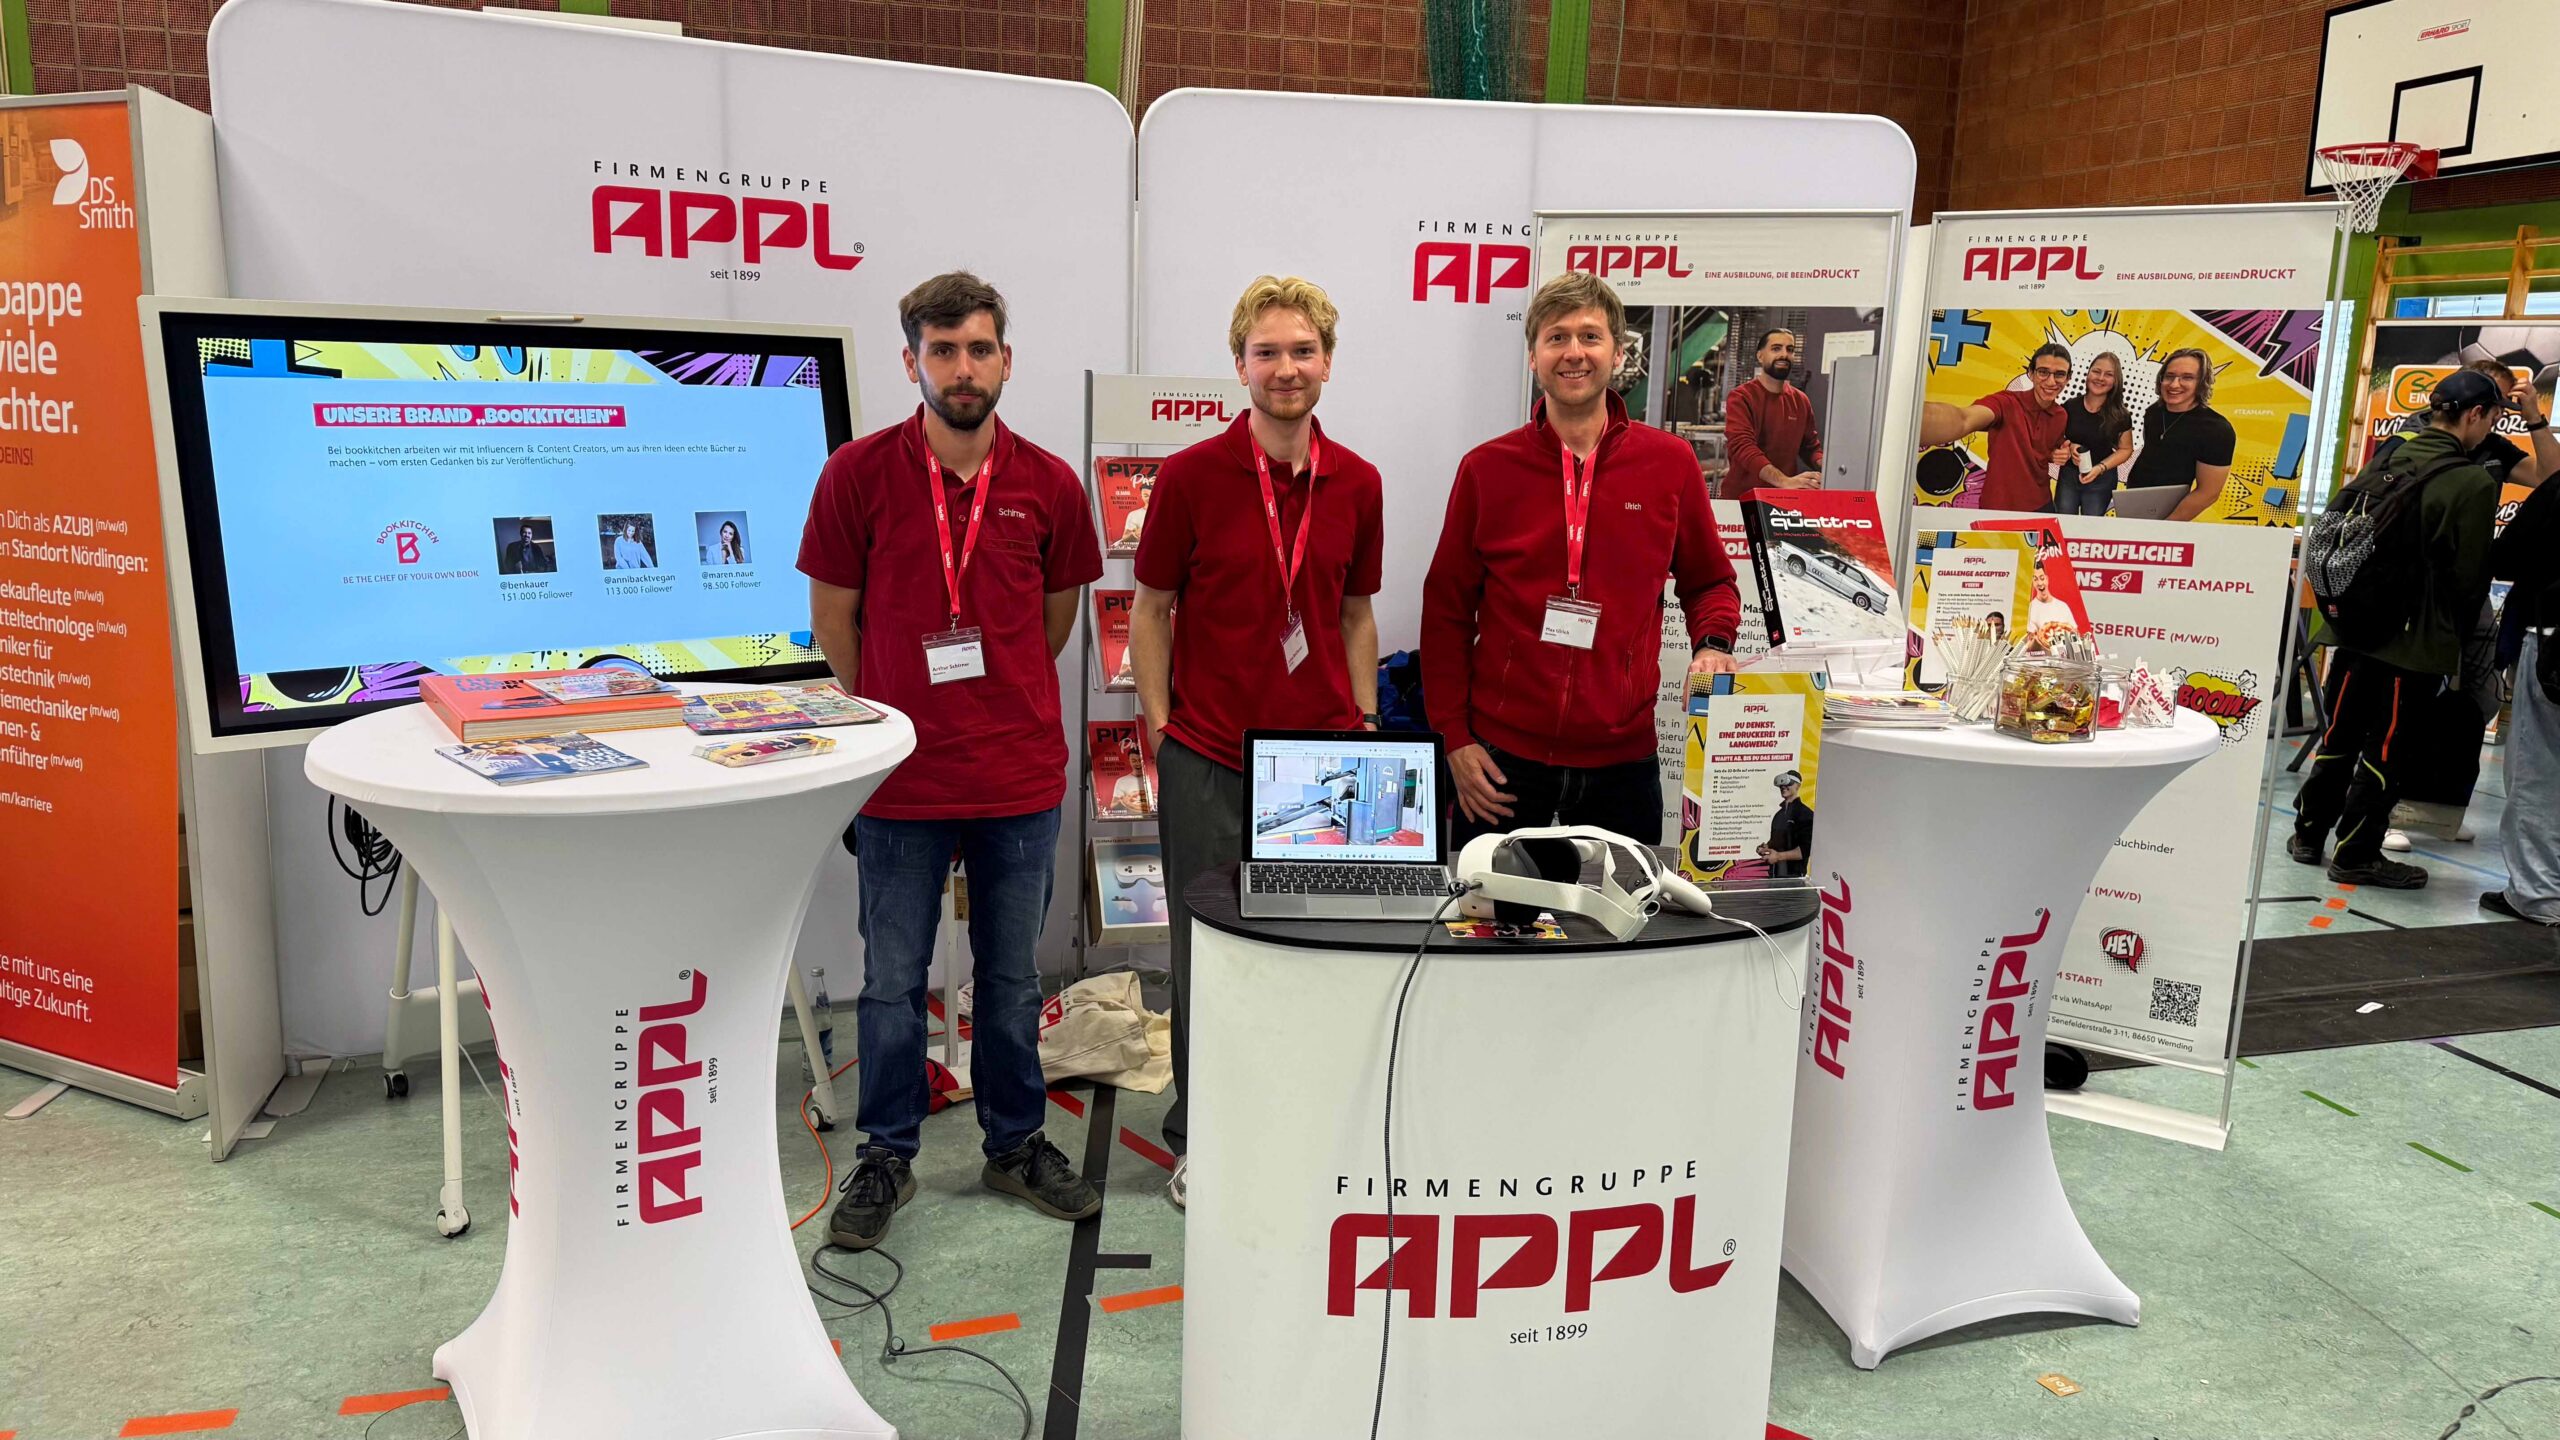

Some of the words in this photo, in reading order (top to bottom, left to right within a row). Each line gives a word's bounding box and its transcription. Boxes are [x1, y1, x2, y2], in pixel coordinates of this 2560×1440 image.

[593, 160, 828, 193] FIRMENGRUPPE
[90, 176, 115, 205] DS
[78, 200, 134, 229] Smith
[1418, 220, 1542, 237] FIRMENG
[1569, 234, 1679, 242] FIRMENGRUPPE
[1968, 233, 2089, 243] FIRMENGRUPPE
[710, 268, 729, 279] seit
[733, 269, 761, 281] 1899
[1704, 271, 1722, 279] EINE
[1723, 271, 1774, 281] AUSBILDUNG,
[1776, 271, 1789, 279] DIE
[1790, 268, 1860, 279] BEEINDRUCKT
[2116, 272, 2136, 281] EINE
[2137, 271, 2197, 282] AUSBILDUNG,
[2198, 271, 2213, 281] DIE
[2214, 268, 2297, 281] BEEINDRUCKT
[1506, 311, 1522, 321] seit
[322, 407, 402, 424] UNSERE
[404, 408, 472, 424] BRAND
[327, 446, 342, 455] Bei
[345, 446, 401, 455] bookkitchen
[404, 446, 440, 455] arbeiten
[443, 446, 456, 454] wir
[459, 445, 474, 454] mit
[476, 445, 524, 454] Influencern
[526, 445, 534, 453] &
[537, 445, 570, 454] Content
[573, 444, 609, 455] Creators,
[611, 445, 624, 453] um
[642, 444, 661, 453] ihren
[664, 444, 685, 453] Ideen
[687, 444, 708, 453] echte
[710, 444, 735, 453] Bücher
[329, 457, 367, 467] machen
[378, 458, 398, 467] vom
[401, 457, 428, 467] ersten
[430, 457, 473, 467] Gedanken
[476, 456, 488, 466] bis
[491, 457, 504, 466] zur
[506, 456, 575, 467] Veröffentlichung.
[1769, 507, 1802, 517] Audi
[7, 509, 32, 531] Dich
[33, 512, 50, 534] als
[53, 514, 93, 537] AZUBI
[95, 517, 128, 535] (m/w/d)
[1770, 516, 1873, 530] quattro
[376, 520, 440, 545] BOOKKITCHEN
[12, 538, 69, 564] Standort
[71, 544, 149, 575] Nördlingen:
[2066, 541, 2184, 563] BERUFLICHE
[343, 576, 354, 584] BE
[356, 575, 373, 583] THE
[374, 574, 396, 583] CHEF
[397, 573, 408, 582] OF
[410, 572, 433, 581] YOUR
[434, 571, 455, 579] OWN
[456, 570, 480, 578] BOOK
[604, 574, 676, 585] @annibacktvegan
[701, 570, 754, 580] @maren.naue
[500, 581, 549, 590] @benkauer
[606, 585, 639, 596] 113.000
[640, 584, 673, 594] Follower
[703, 581, 729, 590] 98.500
[731, 579, 761, 589] Follower
[2157, 577, 2254, 595] #TEAMAPPL
[74, 587, 104, 605] (m/w/d)
[502, 592, 537, 602] 151.000
[539, 590, 573, 599] Follower
[96, 620, 127, 638] (m/w/d)
[2169, 631, 2220, 648] (M/W/D)
[33, 638, 53, 660] für
[57, 670, 91, 689] (m/w/d)
[2177, 683, 2263, 720] BOOM!
[89, 704, 120, 722] (m/w/d)
[30, 722, 41, 742] &
[1734, 721, 1746, 729] DU
[1718, 731, 1736, 739] EINE
[1736, 730, 1776, 739] DRUCKEREI
[1778, 730, 1790, 738] IST
[1729, 740, 1778, 748] LANGWEILIG?
[50, 754, 83, 772] (m/w/d)
[2095, 885, 2142, 904] (M/W/D)
[2104, 933, 2139, 957] HEY
[12, 955, 35, 978] mit
[37, 964, 60, 985] uns
[62, 968, 94, 994] eine
[1857, 959, 1865, 979] 1899
[2065, 972, 2103, 987] START!
[2030, 979, 2039, 1000] 1899
[34, 988, 93, 1023] Zukunft.
[2059, 995, 2071, 1003] via
[2072, 996, 2113, 1011] WhatsApp!
[1956, 936, 1995, 1111] FIRMENGRUPPE
[2051, 1015, 2112, 1036] Senefelderstraße
[2113, 1027, 2130, 1038] 3-11,
[2132, 1031, 2156, 1043] 86650
[2157, 1037, 2193, 1052] Wemding
[708, 1057, 718, 1083] 1899
[709, 1086, 718, 1104] seit
[615, 1008, 630, 1227] FIRMENGRUPPE
[1337, 1160, 1697, 1198] FIRMENGRUPPE
[1509, 1327, 1539, 1345] seit
[1546, 1322, 1588, 1343] 1899
